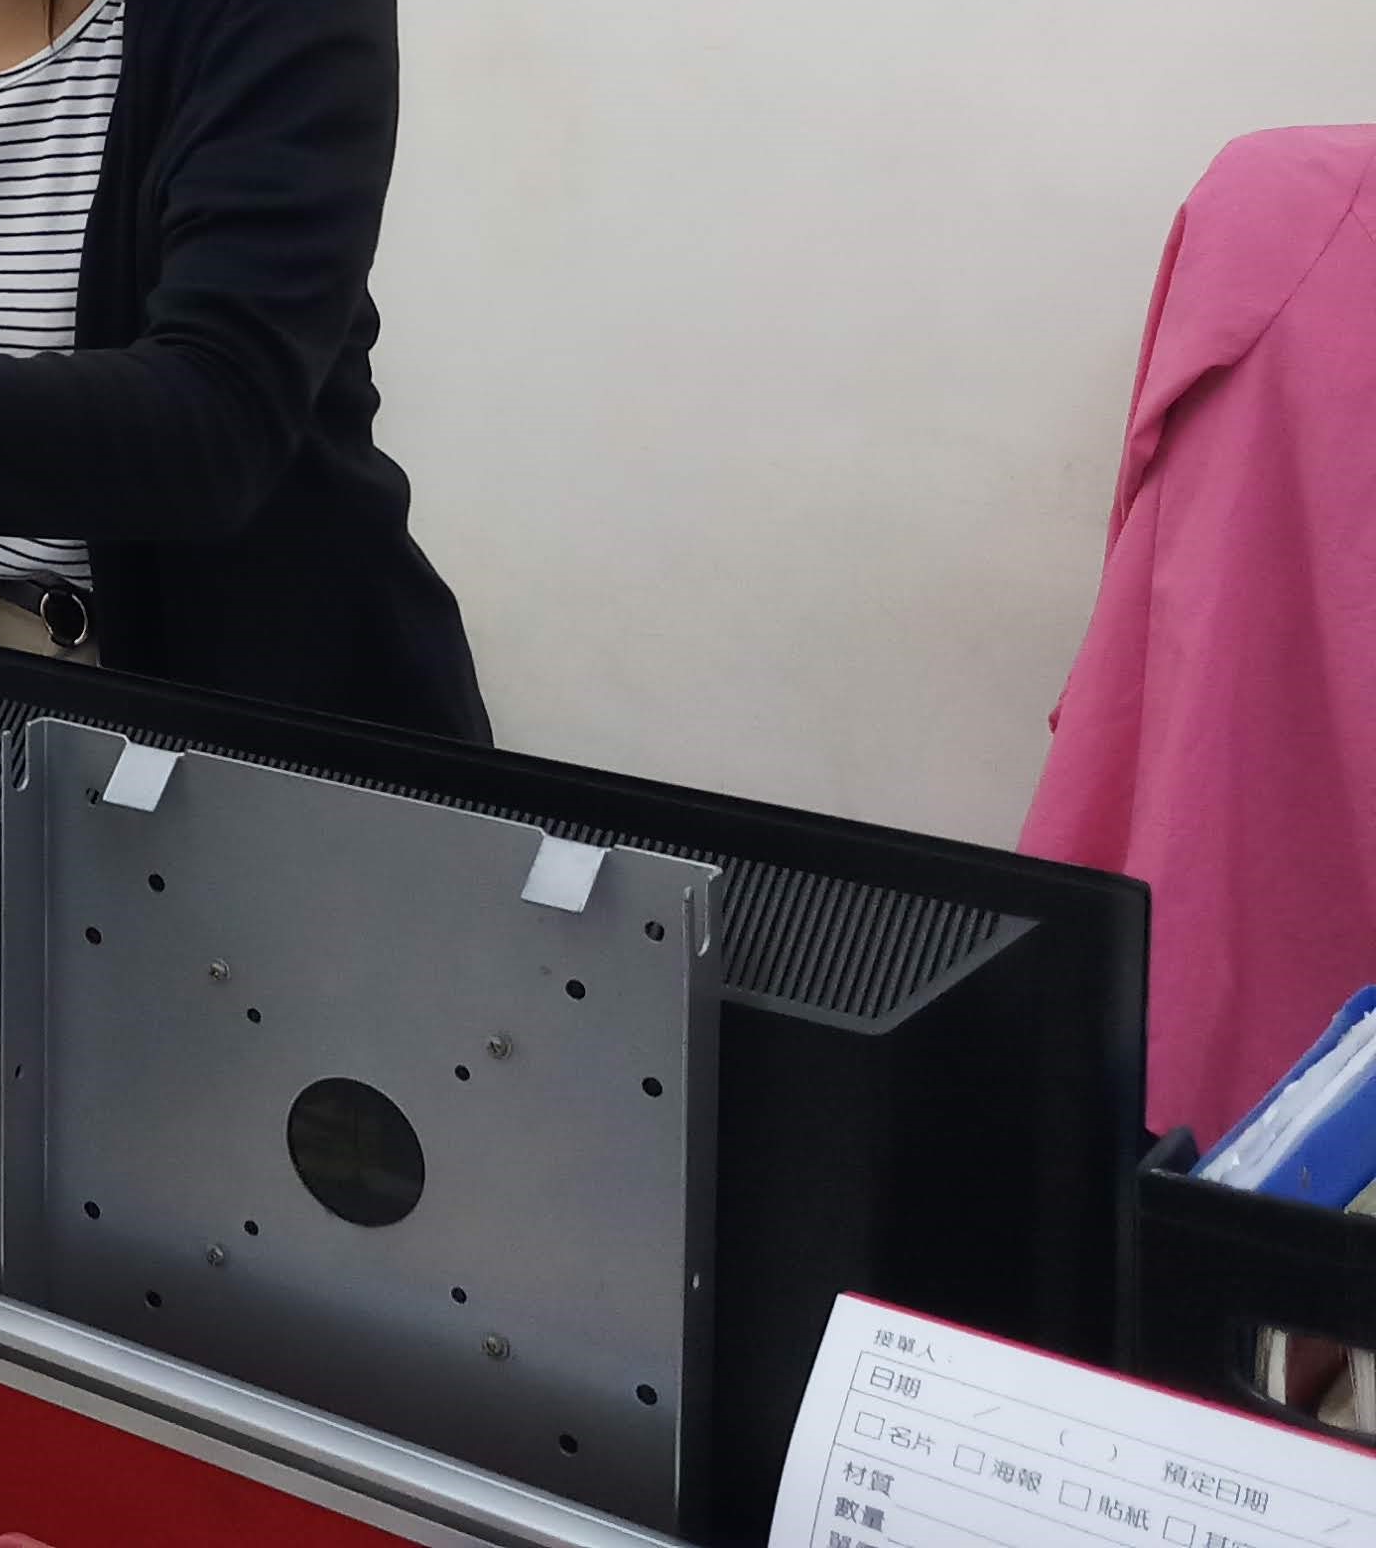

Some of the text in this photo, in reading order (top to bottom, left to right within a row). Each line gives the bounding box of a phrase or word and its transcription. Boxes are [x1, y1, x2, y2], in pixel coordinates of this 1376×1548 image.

[869, 1365, 1270, 1515] 日期 預定日期
[834, 1495, 886, 1533] 數量
[843, 1460, 895, 1498] 材質
[888, 1426, 936, 1456] 名片
[992, 1458, 1043, 1494] 海報
[1096, 1494, 1150, 1532] 貼紙
